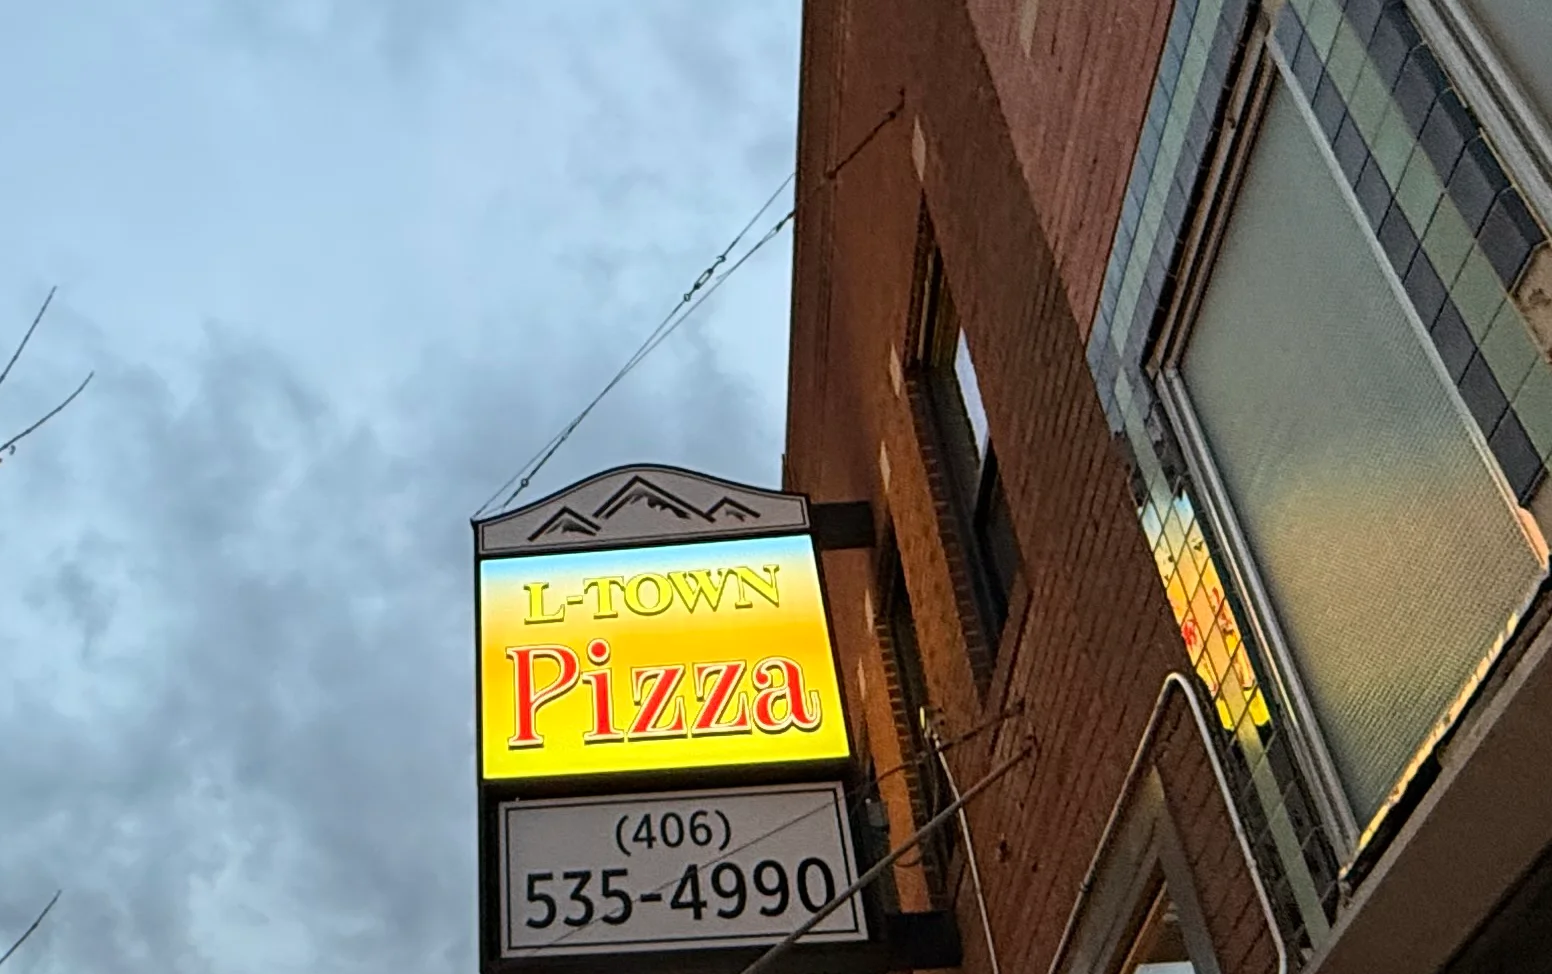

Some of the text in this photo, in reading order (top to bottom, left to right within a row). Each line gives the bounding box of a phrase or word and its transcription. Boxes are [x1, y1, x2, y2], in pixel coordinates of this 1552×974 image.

[523, 564, 781, 624] L-TOWN
[506, 638, 822, 751] Pizza
[615, 809, 732, 856] (406)
[526, 857, 837, 930] 535-4990
